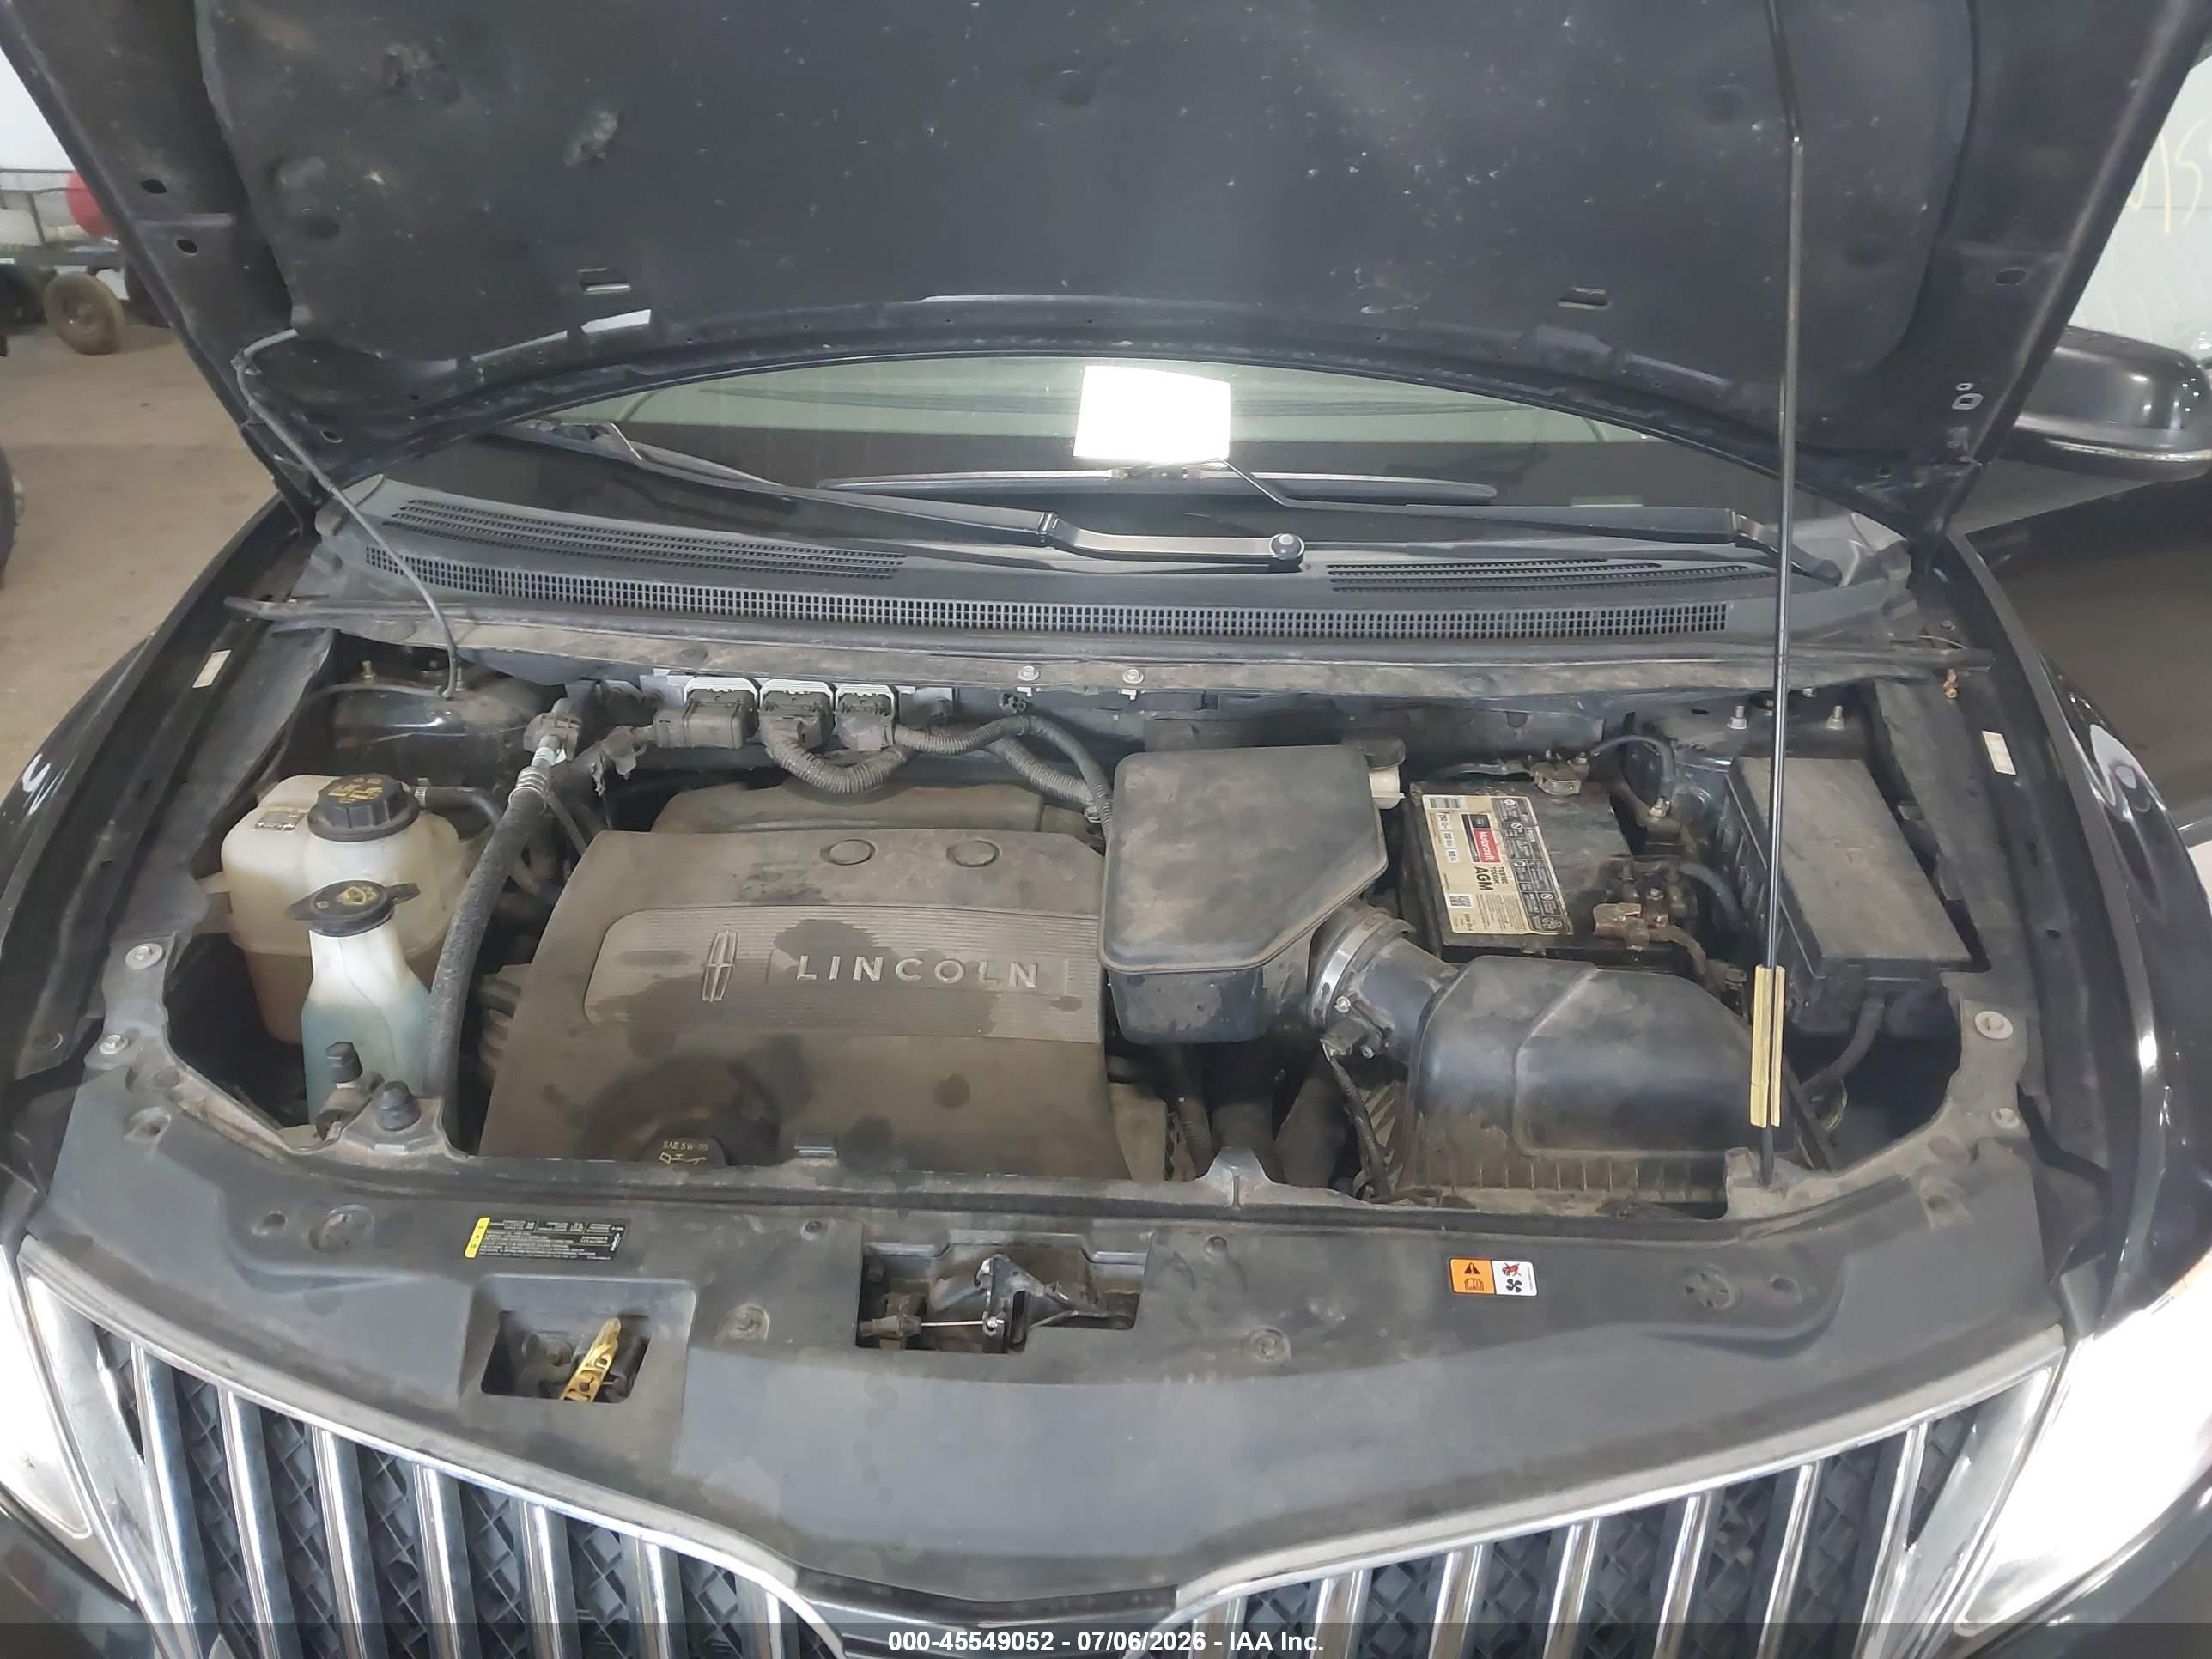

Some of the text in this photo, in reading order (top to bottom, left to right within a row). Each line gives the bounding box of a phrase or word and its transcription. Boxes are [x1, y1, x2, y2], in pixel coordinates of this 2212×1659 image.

[1479, 830, 1495, 860] Motorcraft
[1474, 866, 1494, 891] AGM
[796, 955, 1038, 988] LINCOLN
